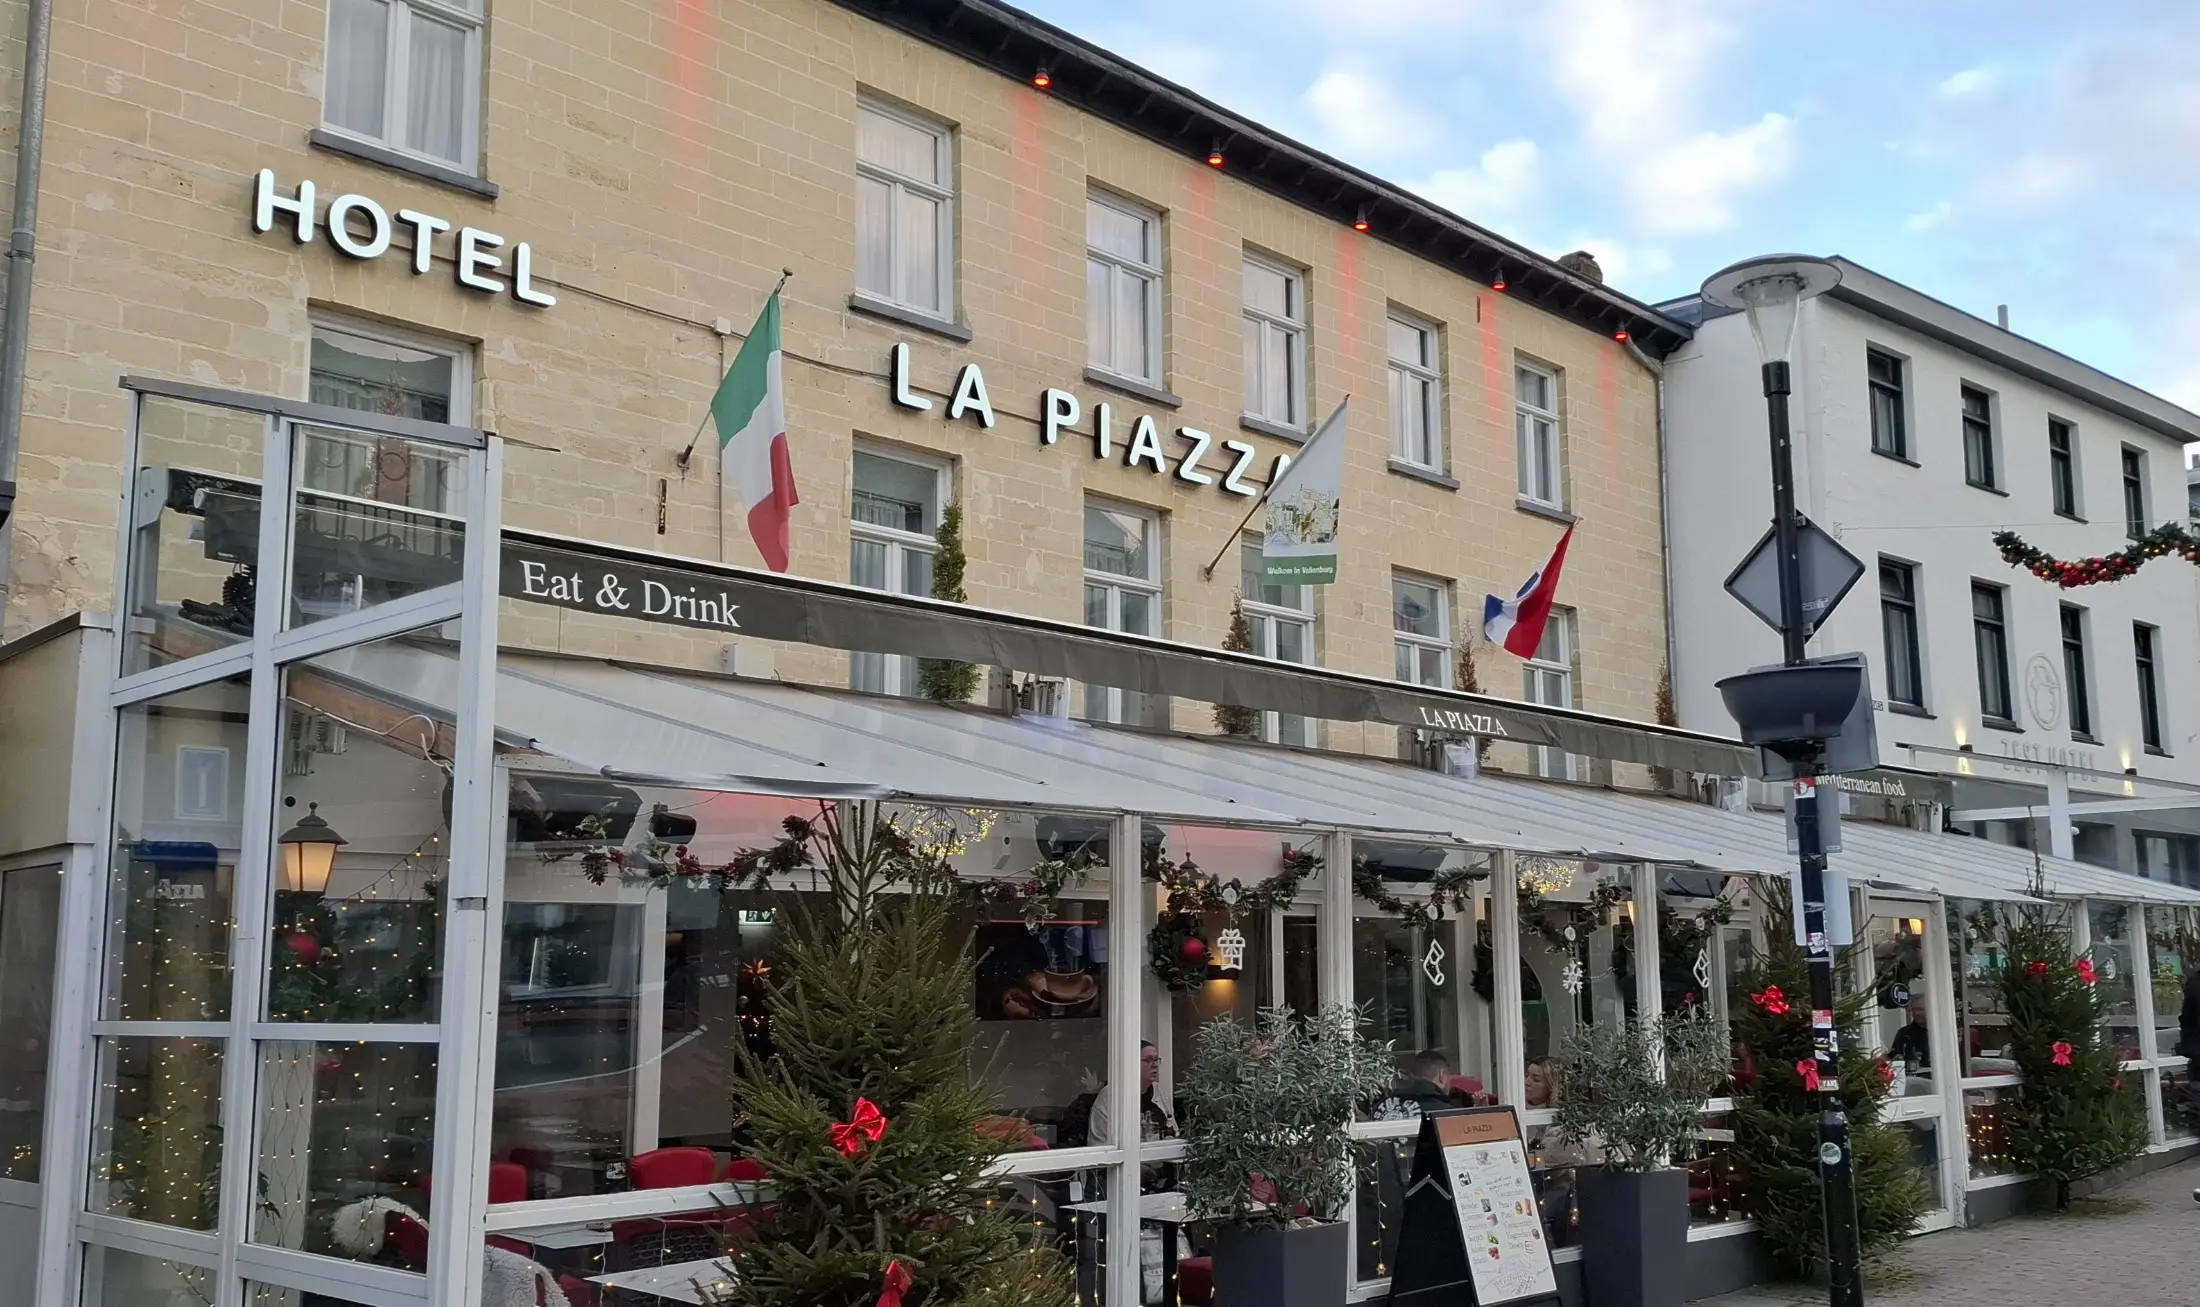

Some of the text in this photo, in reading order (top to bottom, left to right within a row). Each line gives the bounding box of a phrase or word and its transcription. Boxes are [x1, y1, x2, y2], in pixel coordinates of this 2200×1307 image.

[253, 168, 557, 308] HOTEL
[891, 342, 995, 428] LA
[519, 560, 741, 628] Eat & Drink
[1419, 707, 1508, 736] LA PIAZZA
[1883, 778, 1906, 796] food
